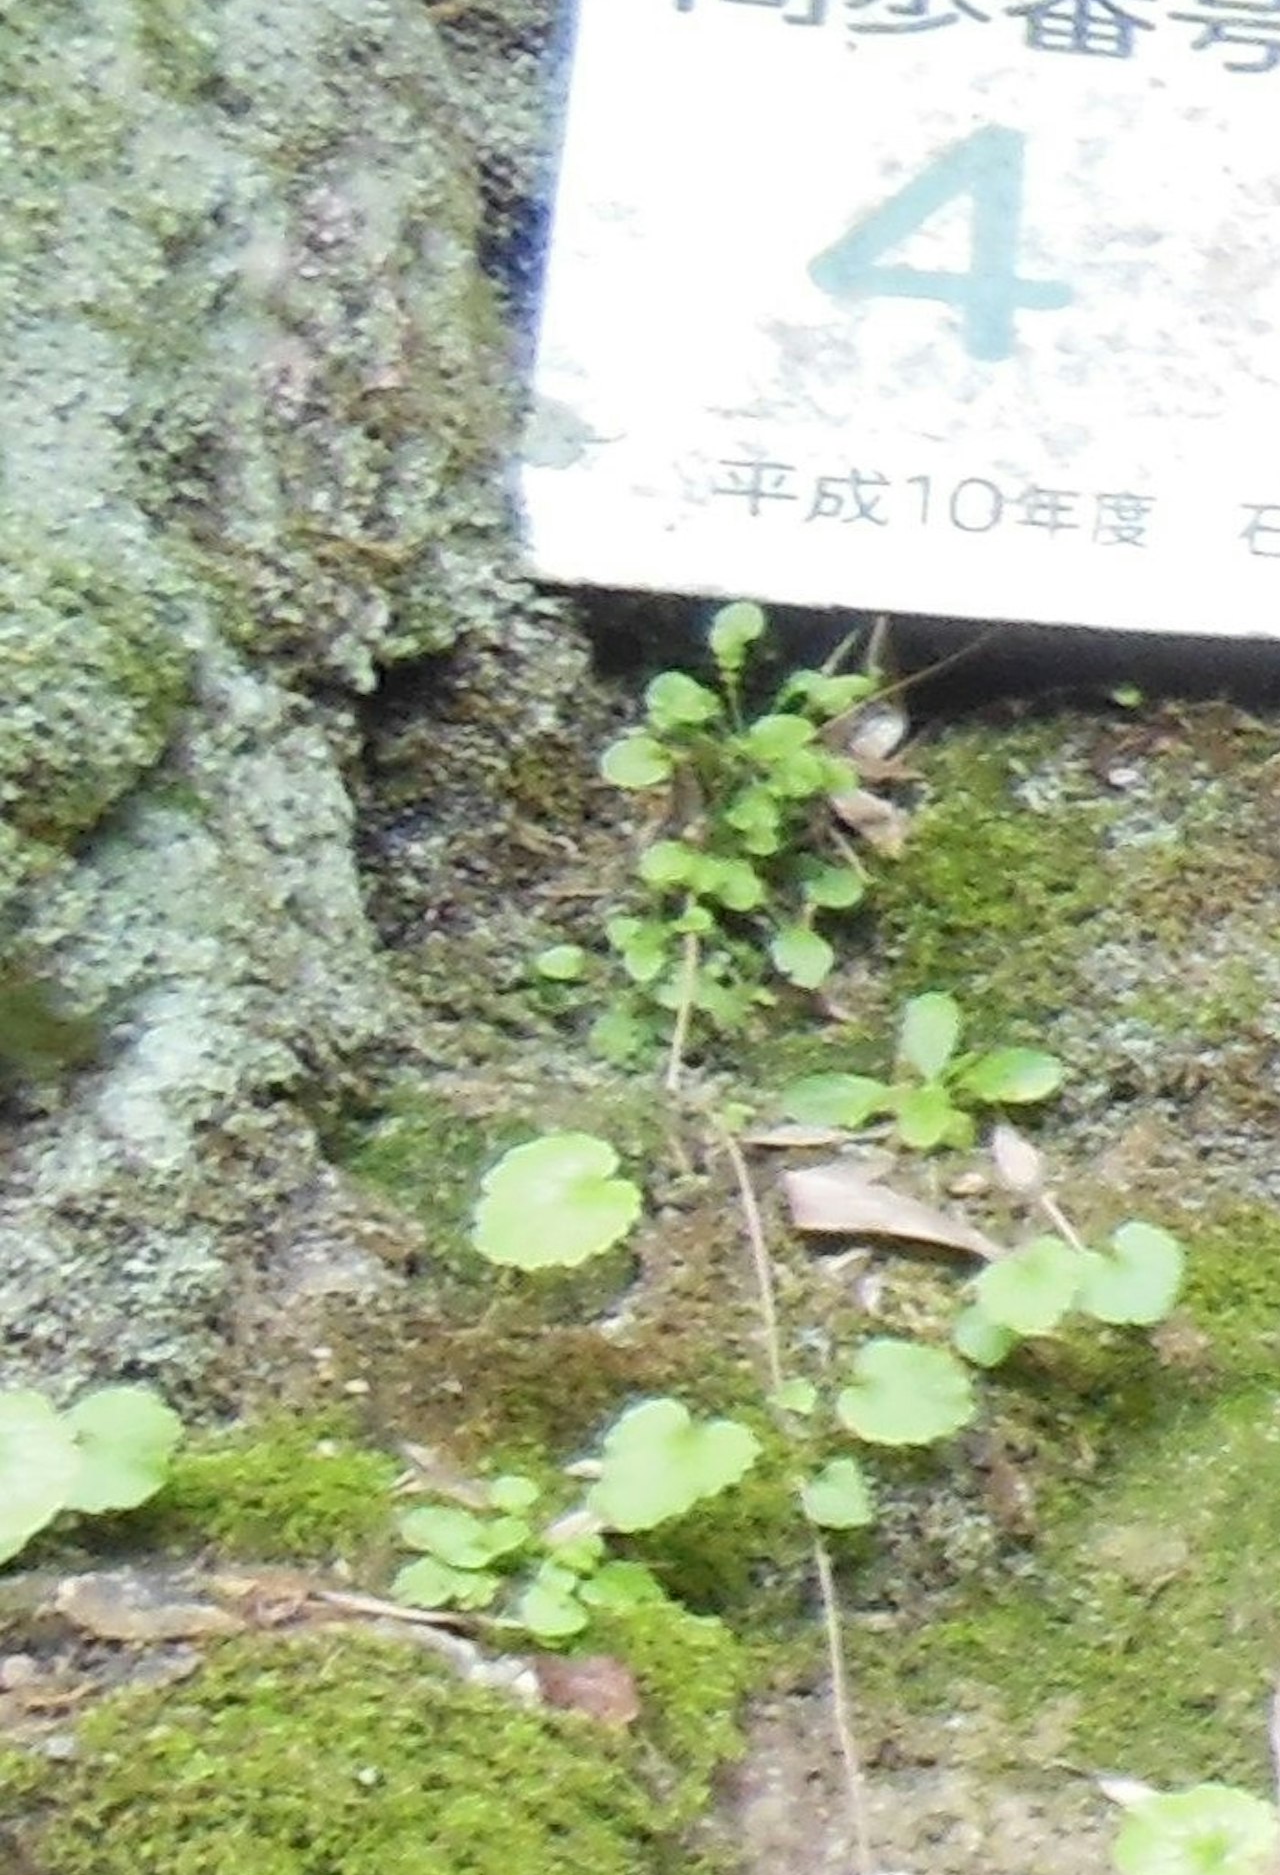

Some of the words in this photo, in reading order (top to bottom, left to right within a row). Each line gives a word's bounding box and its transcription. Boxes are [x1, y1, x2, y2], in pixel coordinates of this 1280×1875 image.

[807, 124, 1072, 362] 4
[713, 458, 1156, 548] 平成10年度
